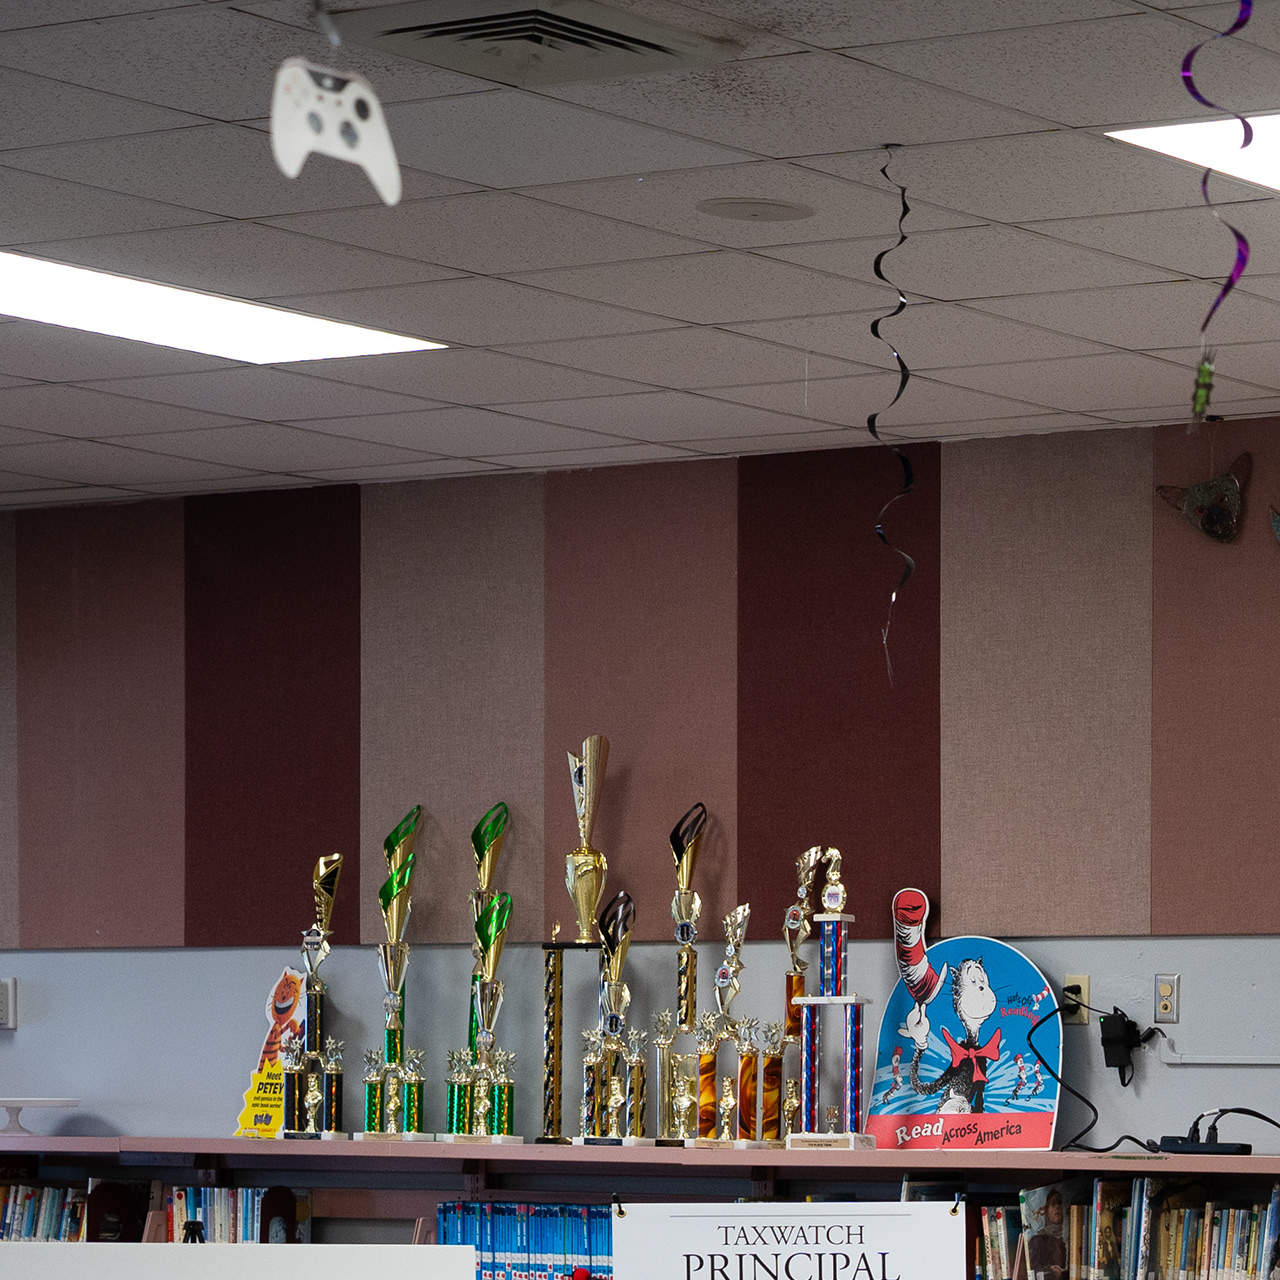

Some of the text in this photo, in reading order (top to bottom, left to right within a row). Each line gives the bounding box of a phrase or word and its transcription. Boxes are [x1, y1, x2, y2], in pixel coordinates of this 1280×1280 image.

[266, 1072, 282, 1080] Meet
[256, 1082, 284, 1094] PETEY
[895, 1118, 944, 1146] Read
[975, 1120, 1022, 1146] America
[717, 1225, 865, 1246] TAXWATCH
